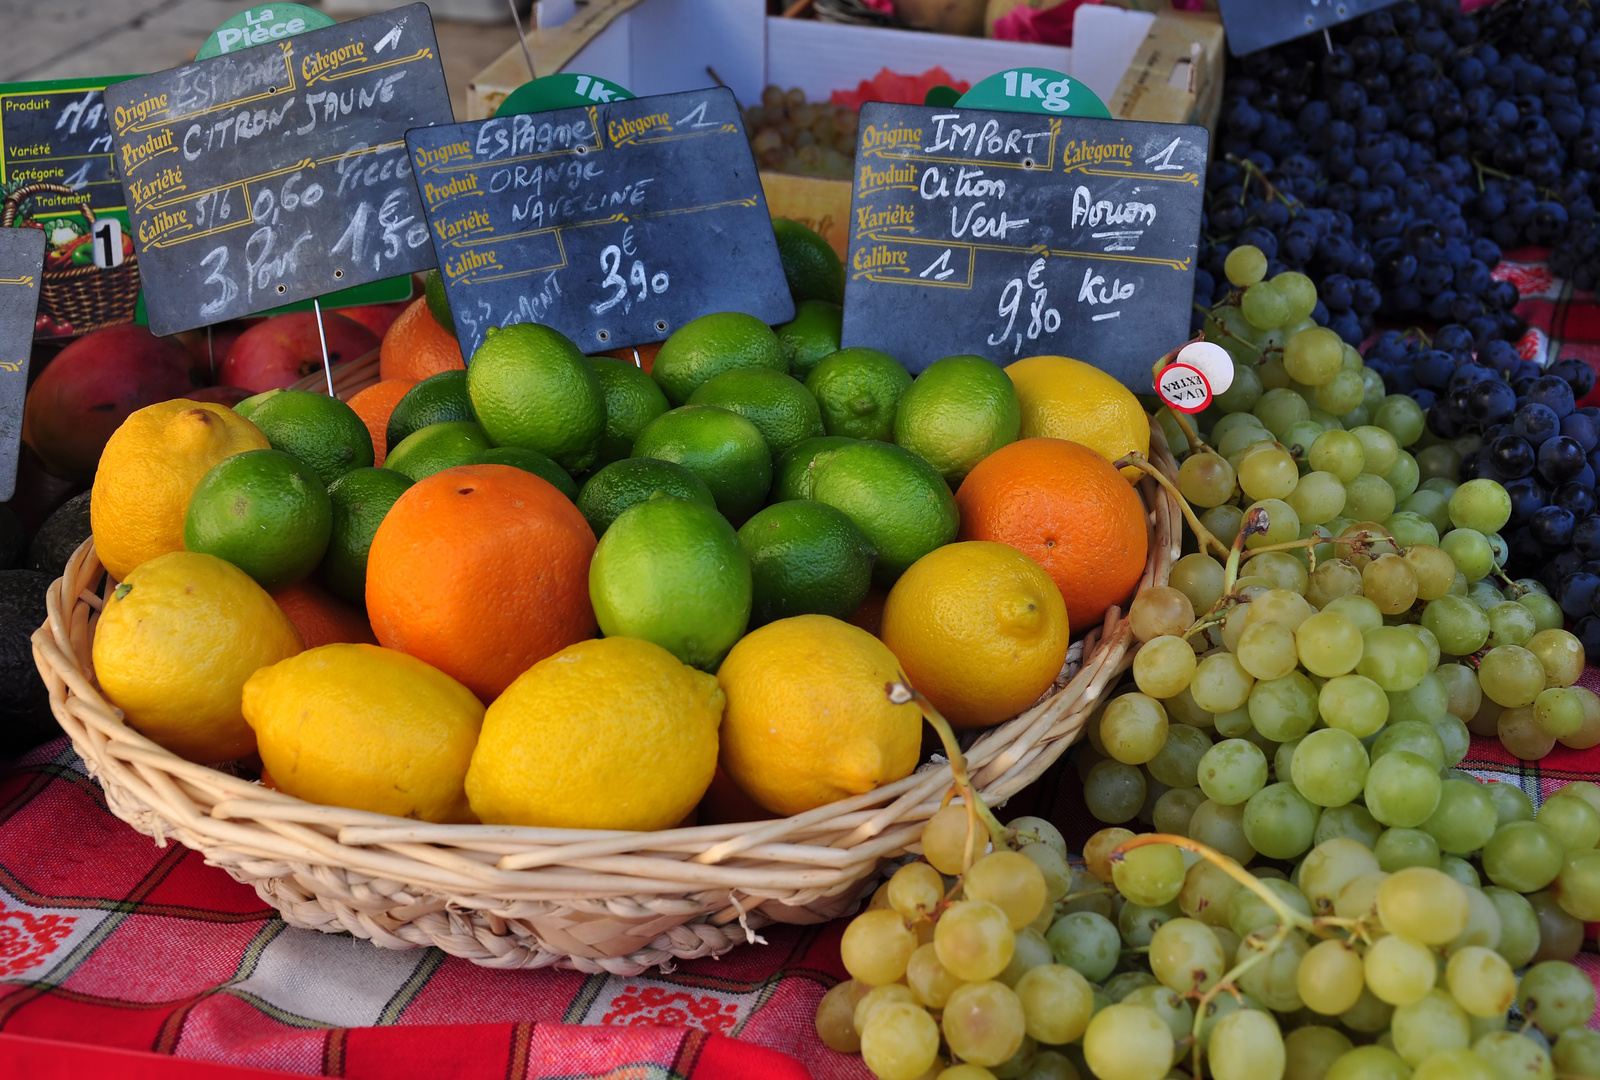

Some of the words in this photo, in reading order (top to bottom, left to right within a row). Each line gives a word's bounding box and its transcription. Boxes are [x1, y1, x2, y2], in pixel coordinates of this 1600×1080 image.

[245, 9, 274, 26] La
[217, 18, 306, 54] Pièce
[302, 38, 364, 80] Catégorie
[5, 99, 51, 112] Produit
[574, 75, 628, 104] 1k
[1003, 71, 1071, 112] 1kg
[114, 93, 168, 130] Origine
[121, 129, 174, 170] Produit
[183, 97, 295, 161] CITRON
[296, 70, 407, 136] JAUNE
[675, 101, 719, 128] 1
[9, 143, 51, 158] Variété
[861, 121, 922, 150] Origine
[924, 114, 1052, 156] IMPORT
[415, 141, 471, 168] Origine
[1063, 137, 1133, 165] Catégorie
[1145, 137, 1184, 171] 1
[11, 167, 64, 182] Catégorie
[128, 165, 183, 208] Variété
[424, 172, 478, 204] Produit
[858, 163, 917, 191] Produit
[35, 193, 92, 207] Traitement
[252, 171, 324, 225] 0,60
[512, 178, 654, 227] NAVELINE
[139, 209, 187, 243] Calibre
[434, 209, 490, 240] Variété
[857, 204, 915, 231] Variété
[951, 201, 1030, 240] Vert
[95, 224, 114, 267] 1
[446, 249, 497, 279] Calibre
[590, 244, 669, 316] 3,90
[853, 245, 908, 270] Calibre
[919, 248, 955, 281] 1
[200, 246, 239, 316] 3
[1162, 375, 1203, 393] EXTRA
[1173, 388, 1205, 401] UVA
